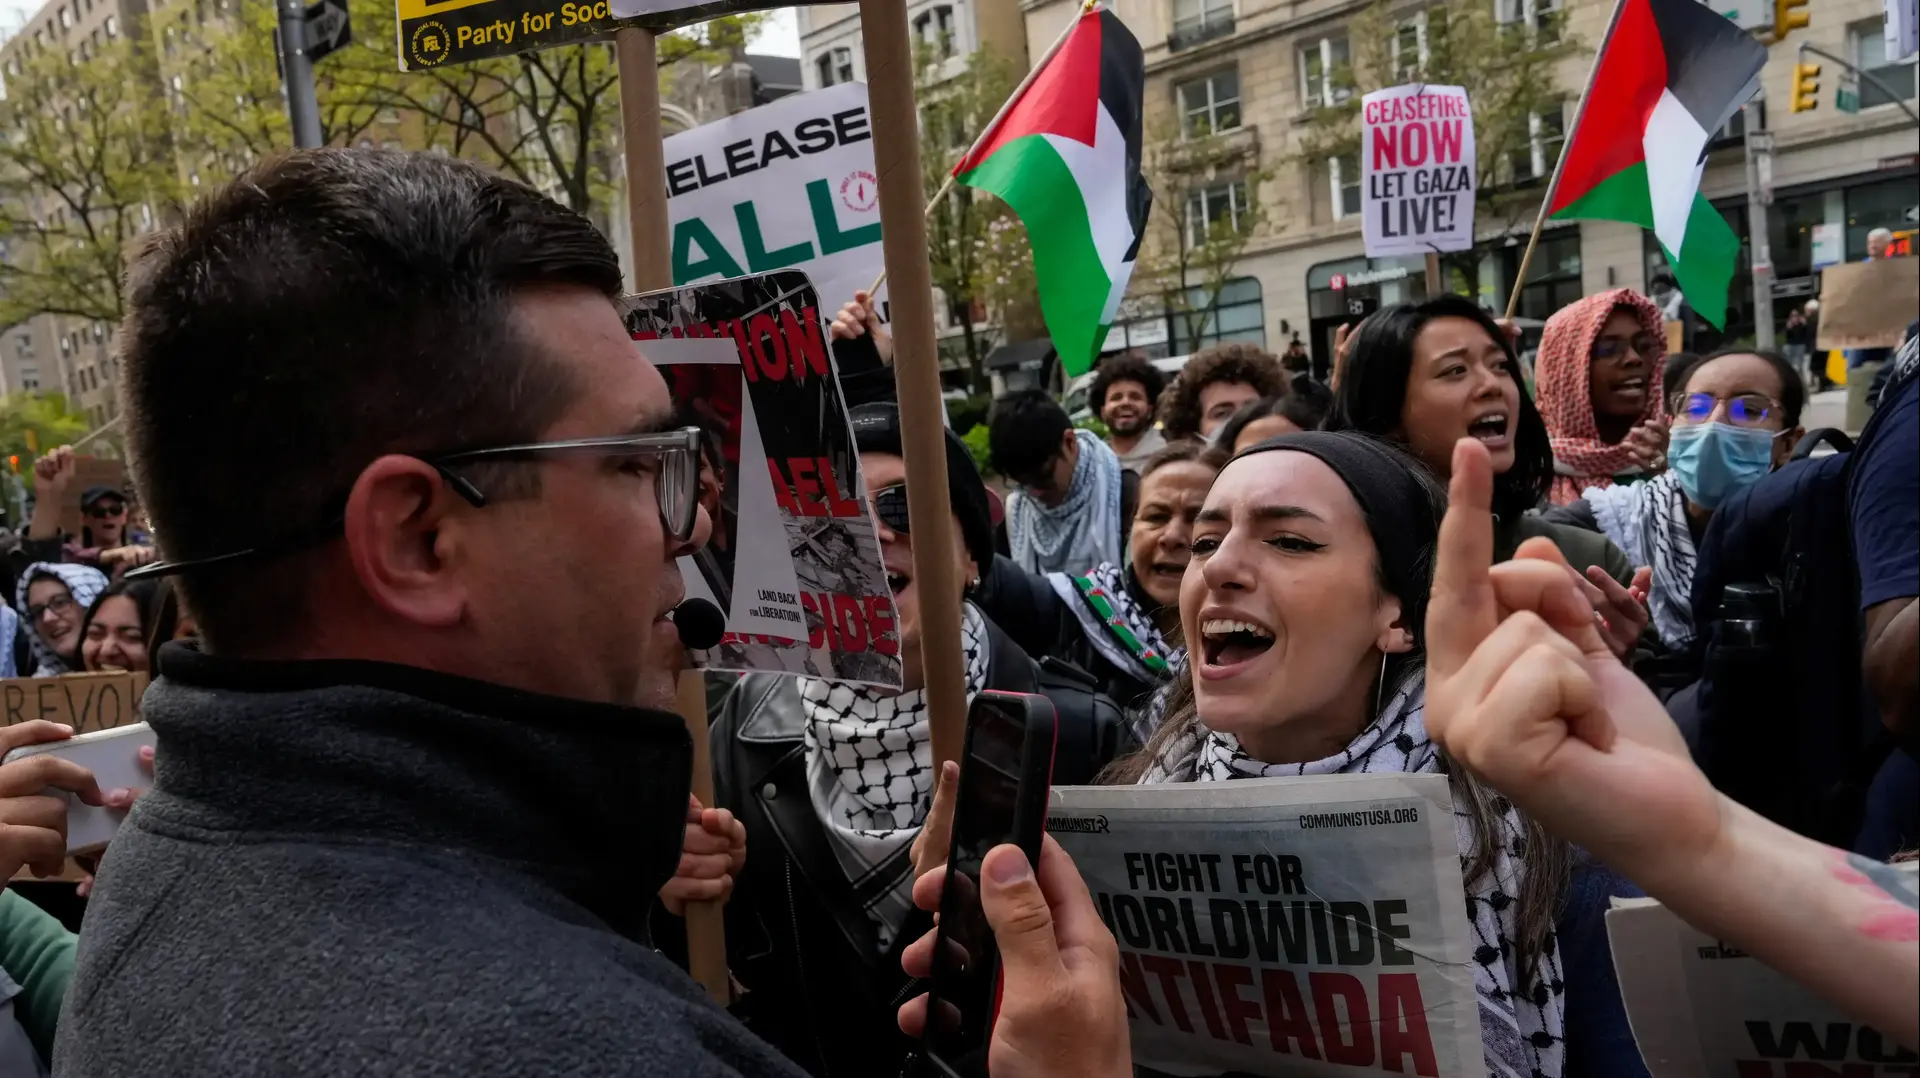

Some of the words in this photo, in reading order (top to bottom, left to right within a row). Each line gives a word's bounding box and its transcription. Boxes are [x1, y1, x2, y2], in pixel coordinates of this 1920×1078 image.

[457, 20, 516, 49] Party
[521, 11, 555, 34] for
[1366, 94, 1468, 125] CEASEFIRE
[665, 106, 872, 199] ELEASE
[1373, 120, 1463, 170] NOW
[1371, 172, 1406, 200] LET
[1414, 165, 1470, 195] GAZA
[671, 178, 883, 287] ALL
[1381, 195, 1457, 238] LIVE!
[767, 457, 861, 517] AEL
[757, 589, 778, 603] LAND
[778, 591, 798, 606] BACK
[758, 606, 802, 624] LIBERATION!
[1299, 808, 1418, 830] COMMUNISTUSA.ORG
[1123, 852, 1222, 892] FIGHT
[1234, 853, 1308, 896] FOR
[1118, 950, 1440, 1078] NTIFADA
